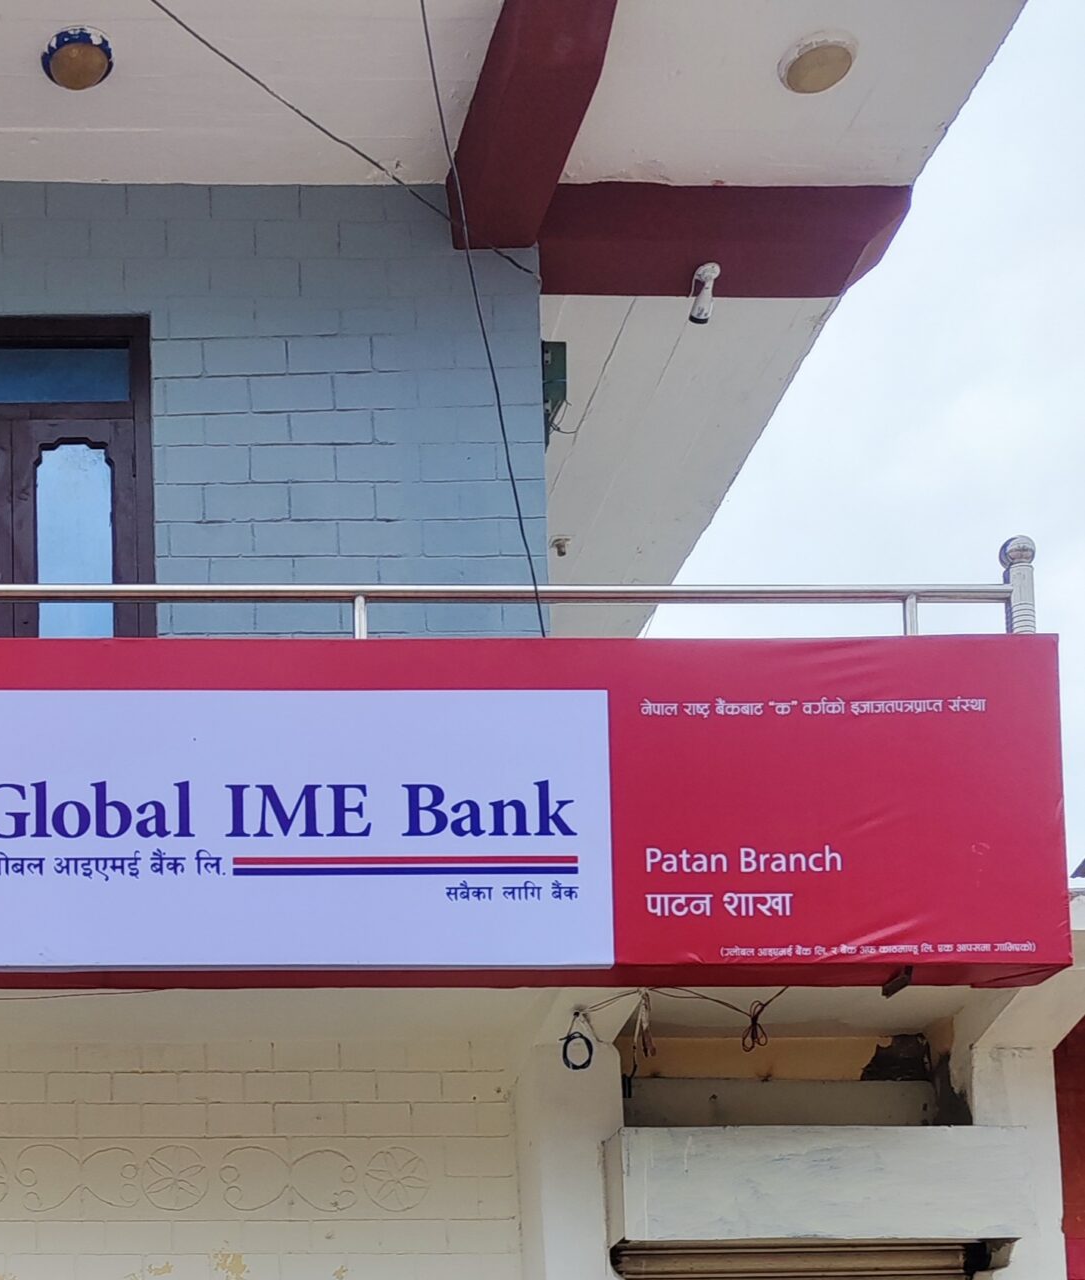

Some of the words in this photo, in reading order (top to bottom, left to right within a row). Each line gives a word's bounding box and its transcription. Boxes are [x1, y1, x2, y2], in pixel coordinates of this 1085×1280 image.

[640, 698, 679, 716] नेपाल
[714, 697, 764, 716] बैंकबाट
[802, 697, 846, 715] वर्गको
[850, 698, 944, 716] इजाजतपत्रप्राप्त
[947, 695, 987, 712] संस्था
[224, 783, 372, 838] IME
[401, 780, 578, 837] Bank
[53, 851, 142, 881] आइएमई
[149, 849, 186, 876] बैंक
[194, 850, 227, 876] लि.
[644, 847, 728, 873] Patan
[740, 845, 843, 872] Branch
[445, 882, 493, 902] सबैका
[502, 881, 542, 901] लागि
[551, 880, 579, 901] बैंक
[645, 892, 713, 917] पाटन
[723, 892, 793, 916] शाखा
